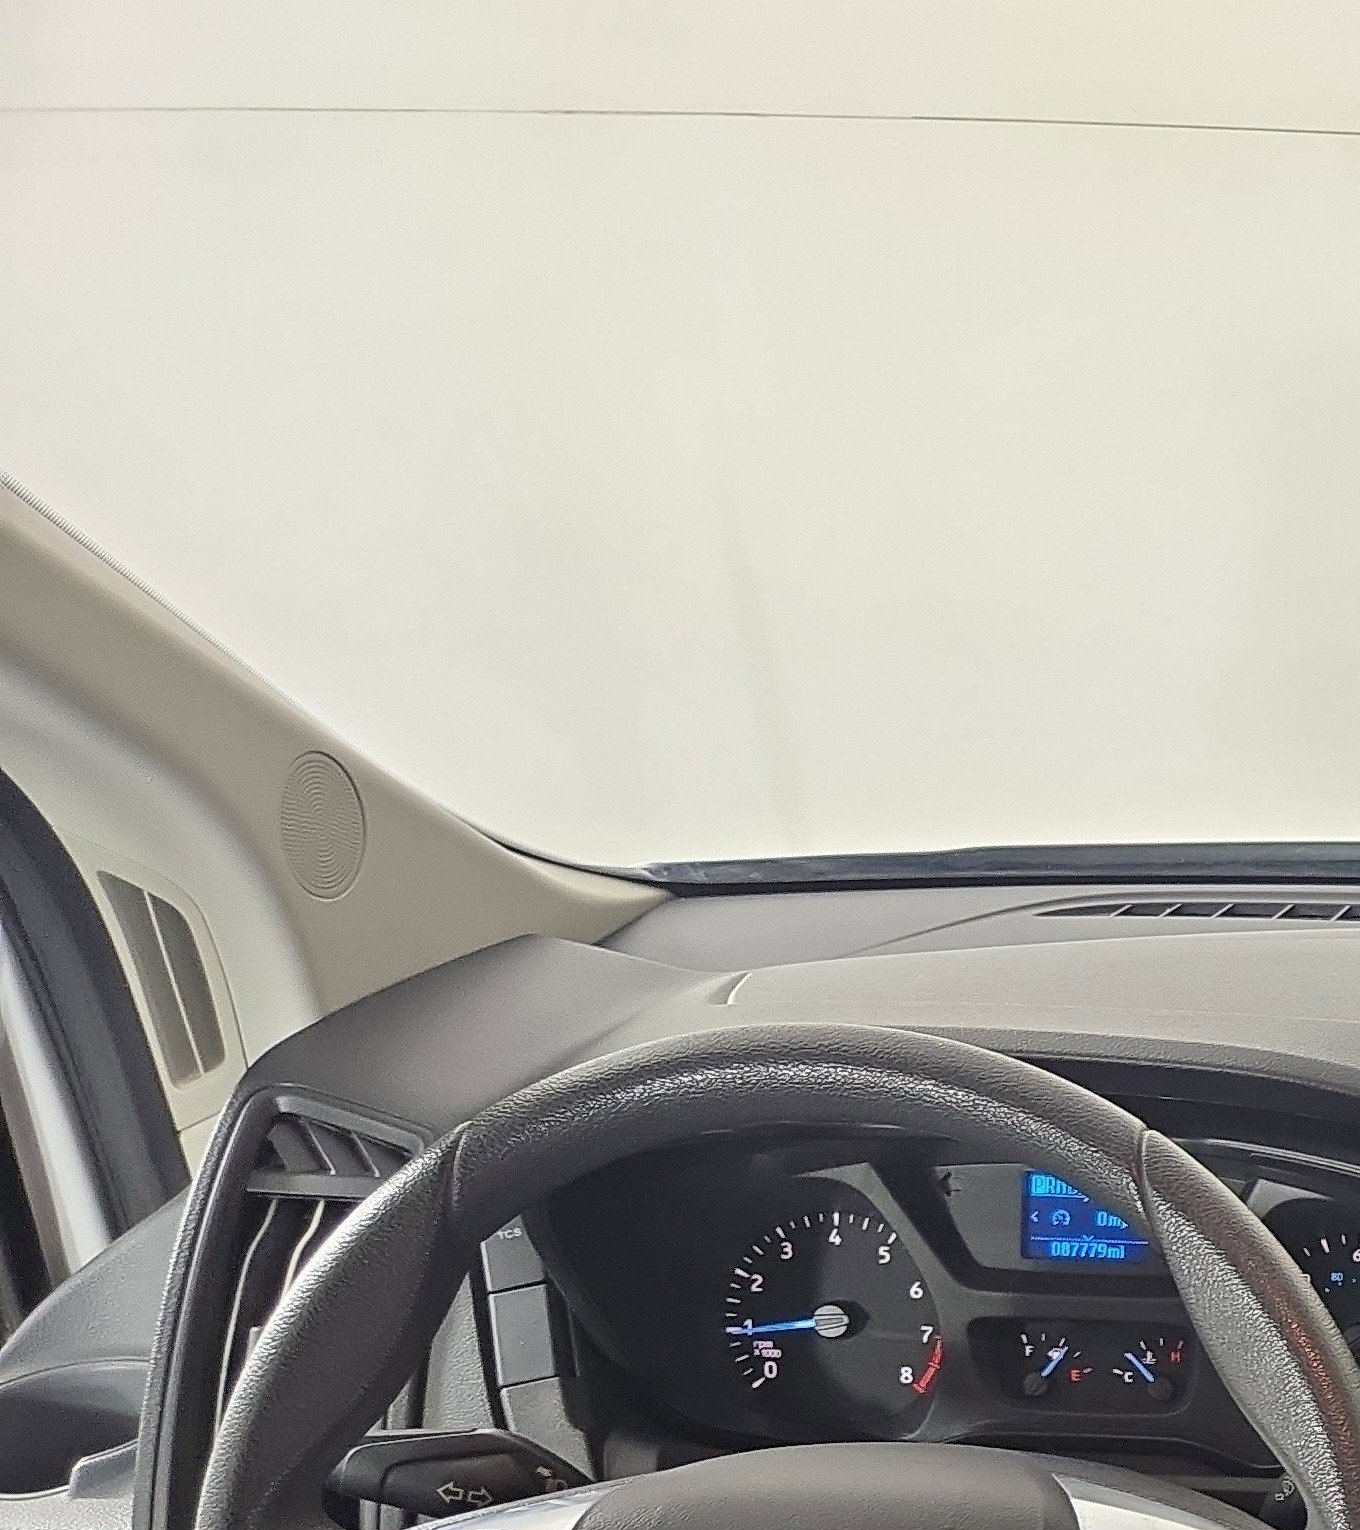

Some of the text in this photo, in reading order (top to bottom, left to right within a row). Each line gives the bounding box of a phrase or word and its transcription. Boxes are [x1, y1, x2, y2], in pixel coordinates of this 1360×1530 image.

[828, 1228, 842, 1245] 4
[780, 1242, 793, 1259] 3
[878, 1245, 891, 1264] 5
[750, 1274, 764, 1292] 2
[909, 1282, 923, 1299] 6
[920, 1325, 933, 1343] 7
[1024, 1345, 1034, 1357] F
[1170, 1351, 1181, 1362] H
[763, 1361, 777, 1379] 0
[900, 1366, 913, 1383] 8
[1070, 1369, 1082, 1382] E
[1123, 1371, 1133, 1383] C
